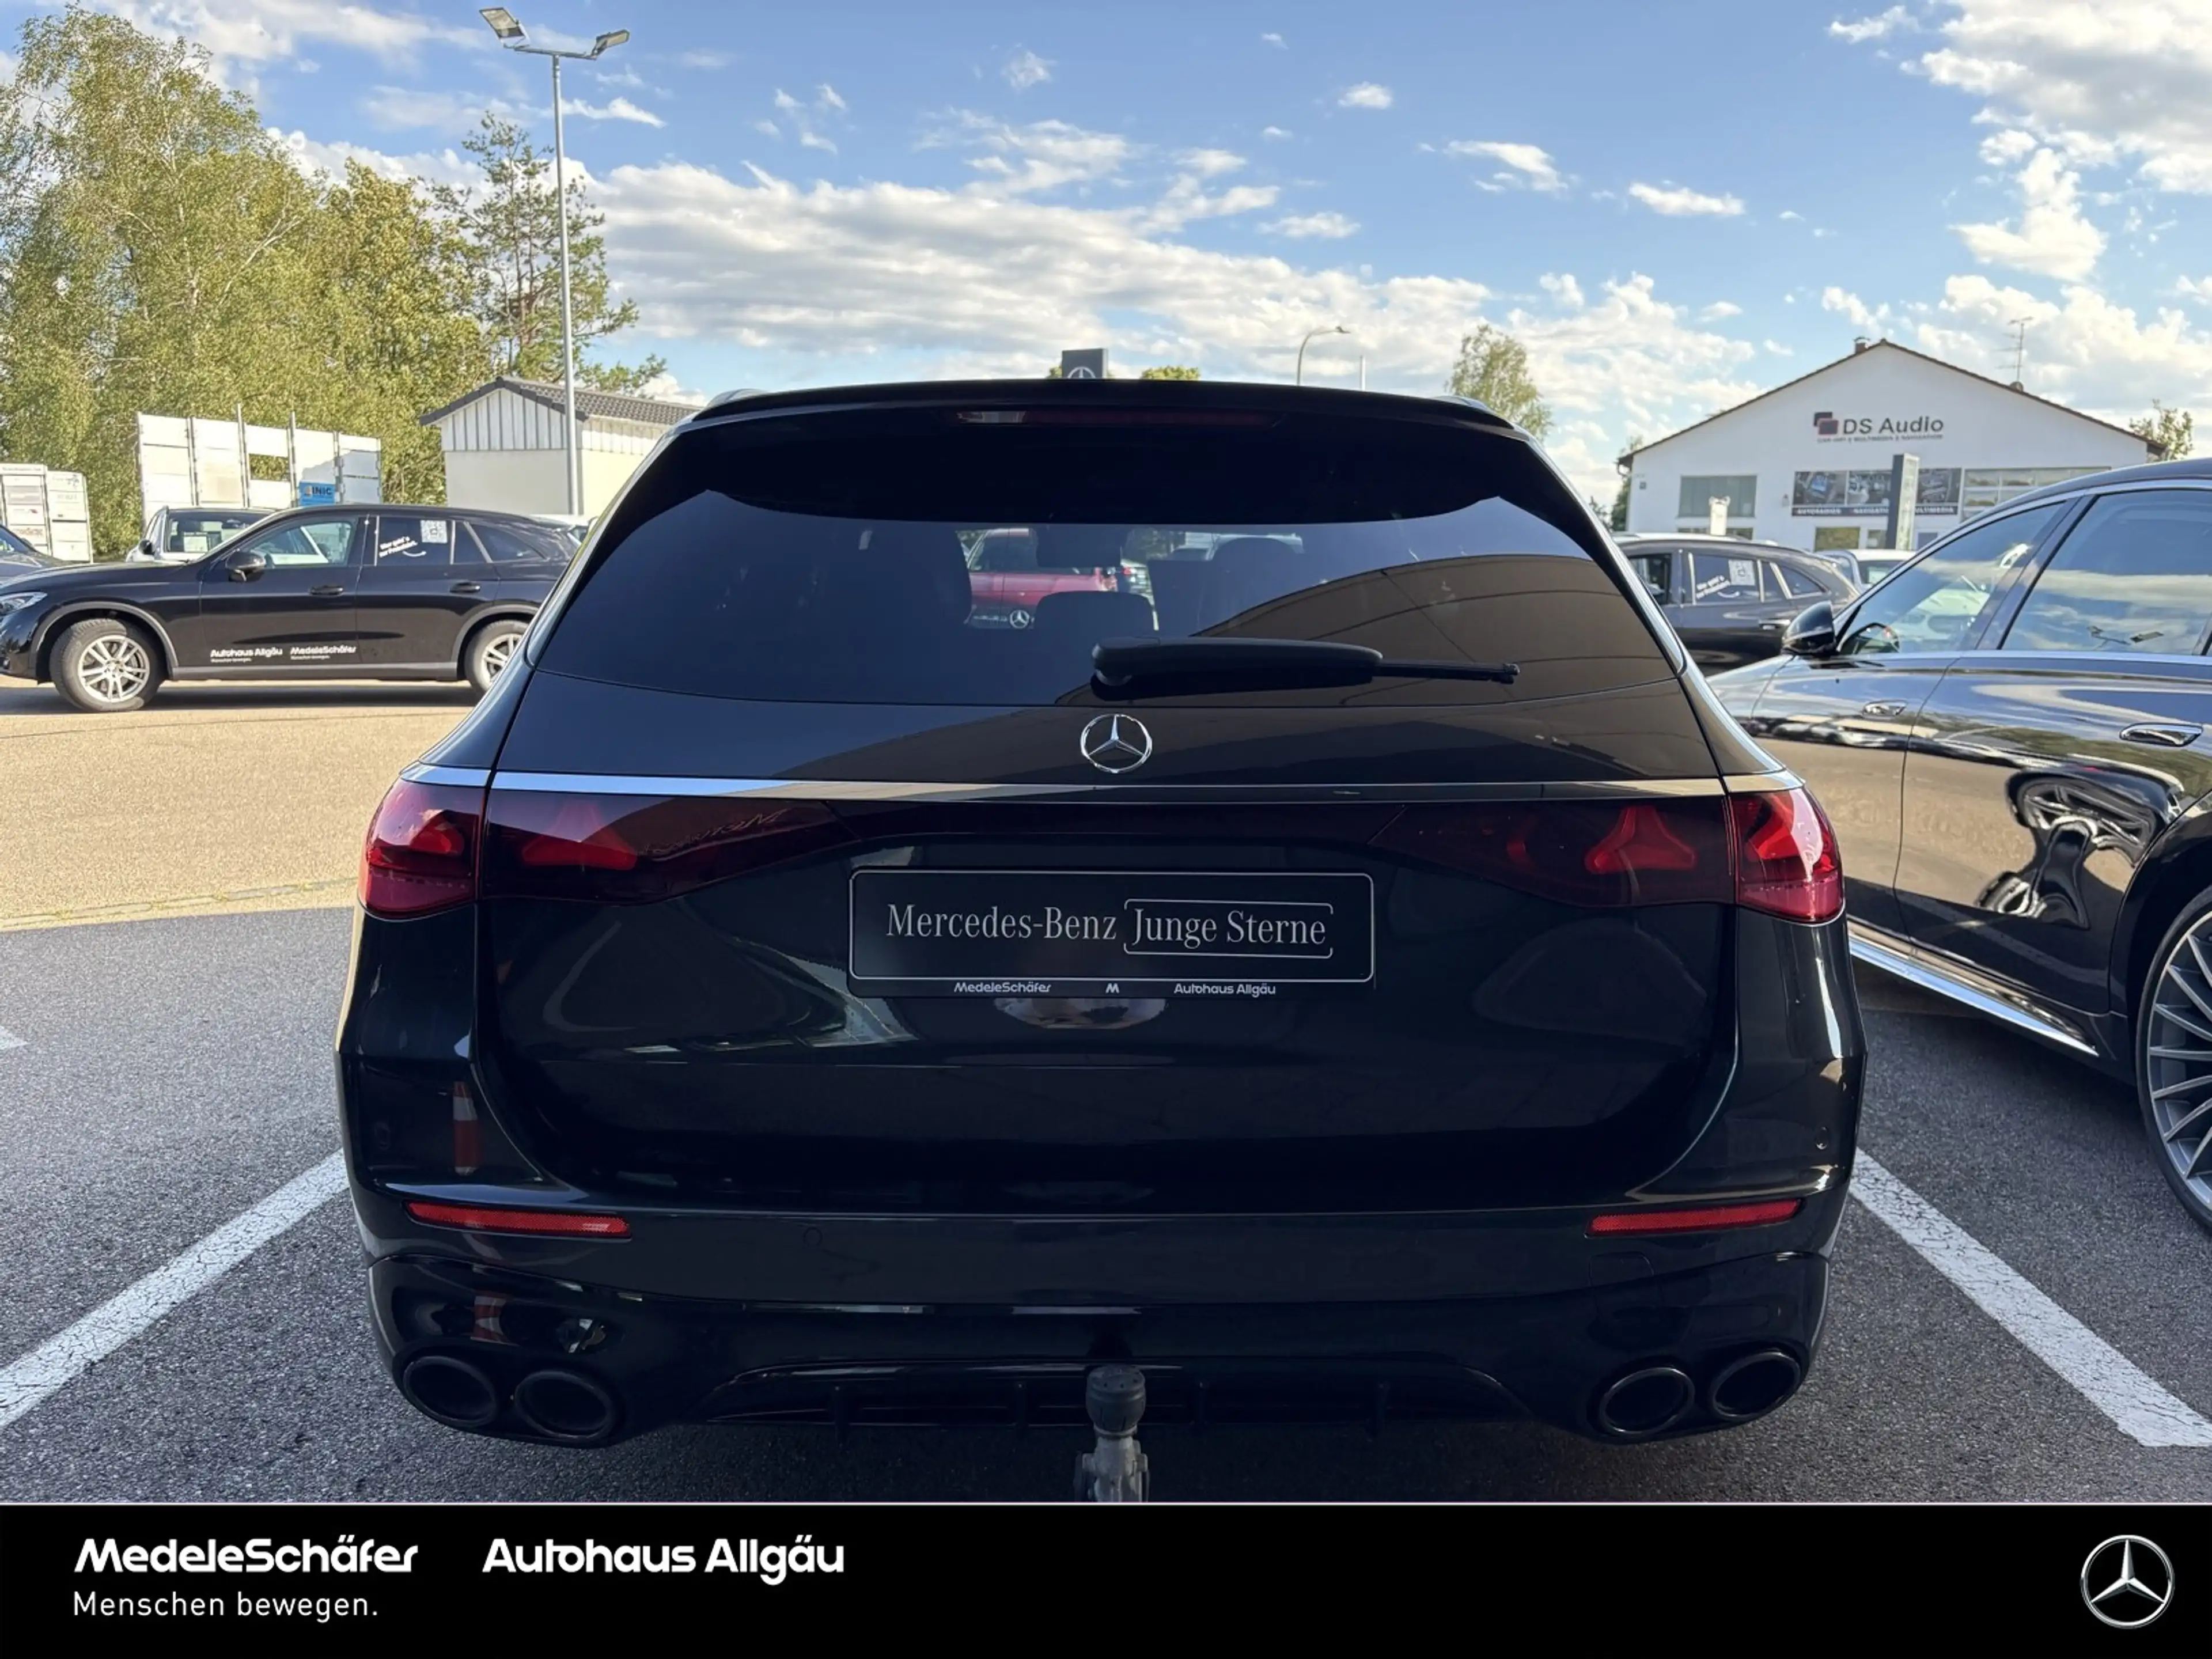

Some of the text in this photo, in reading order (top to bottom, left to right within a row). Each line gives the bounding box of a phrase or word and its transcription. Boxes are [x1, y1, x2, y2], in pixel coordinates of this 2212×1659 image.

[1844, 416, 1944, 435] DS Audio
[210, 649, 253, 658] Autohaus
[255, 647, 283, 657] Allgäu
[887, 904, 1327, 949] Mercedes-Benz Junge Sterne
[953, 981, 1052, 993] MedeleSchäfer
[1173, 982, 1276, 998] Autohaus Allgäu
